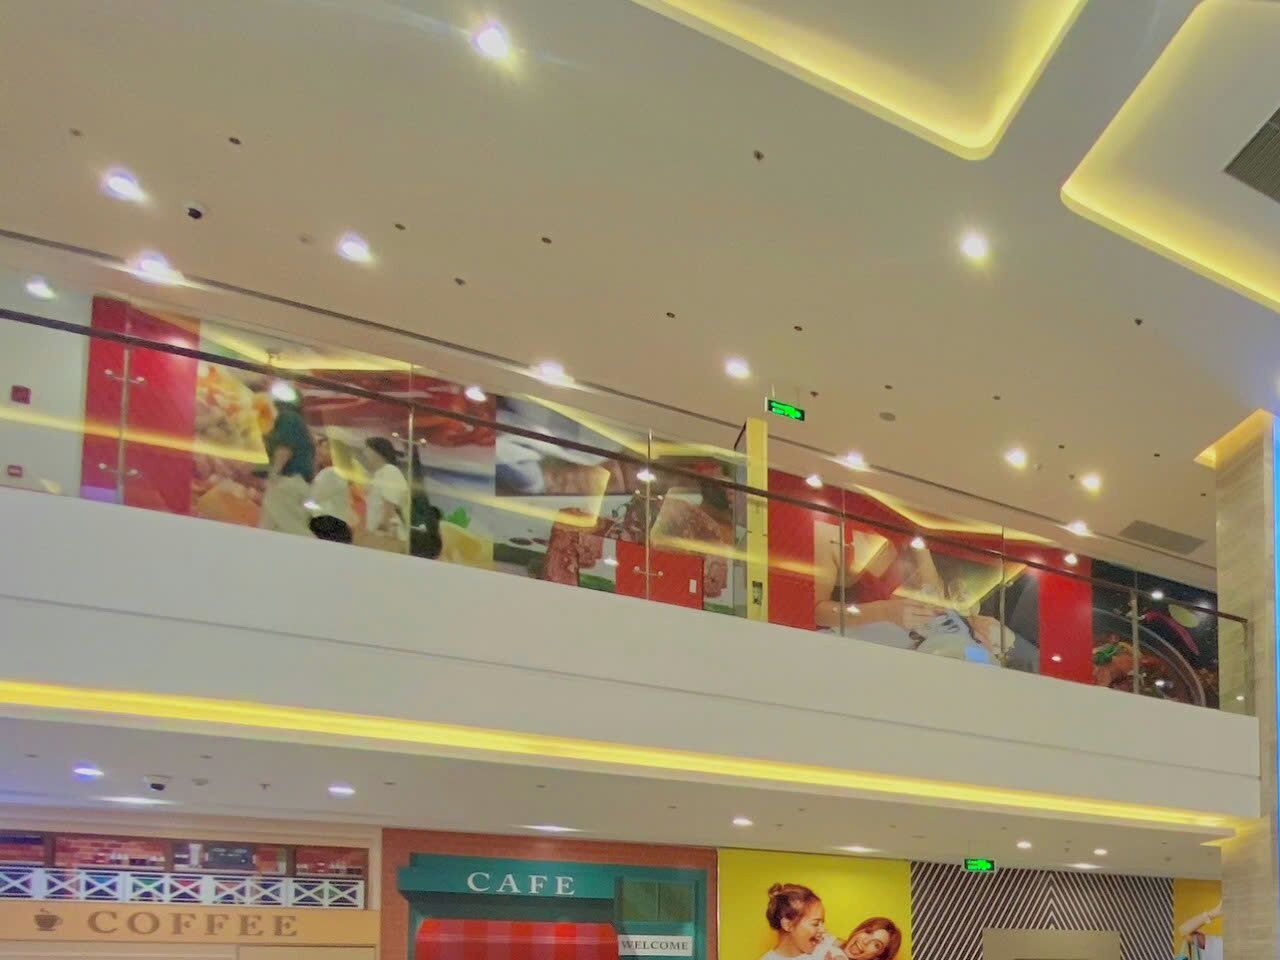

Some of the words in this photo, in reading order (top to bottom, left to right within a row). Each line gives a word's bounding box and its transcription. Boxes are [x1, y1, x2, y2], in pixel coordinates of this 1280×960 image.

[467, 872, 575, 895] CAFE
[87, 910, 298, 937] COFFEE
[621, 939, 689, 951] WELCOME
